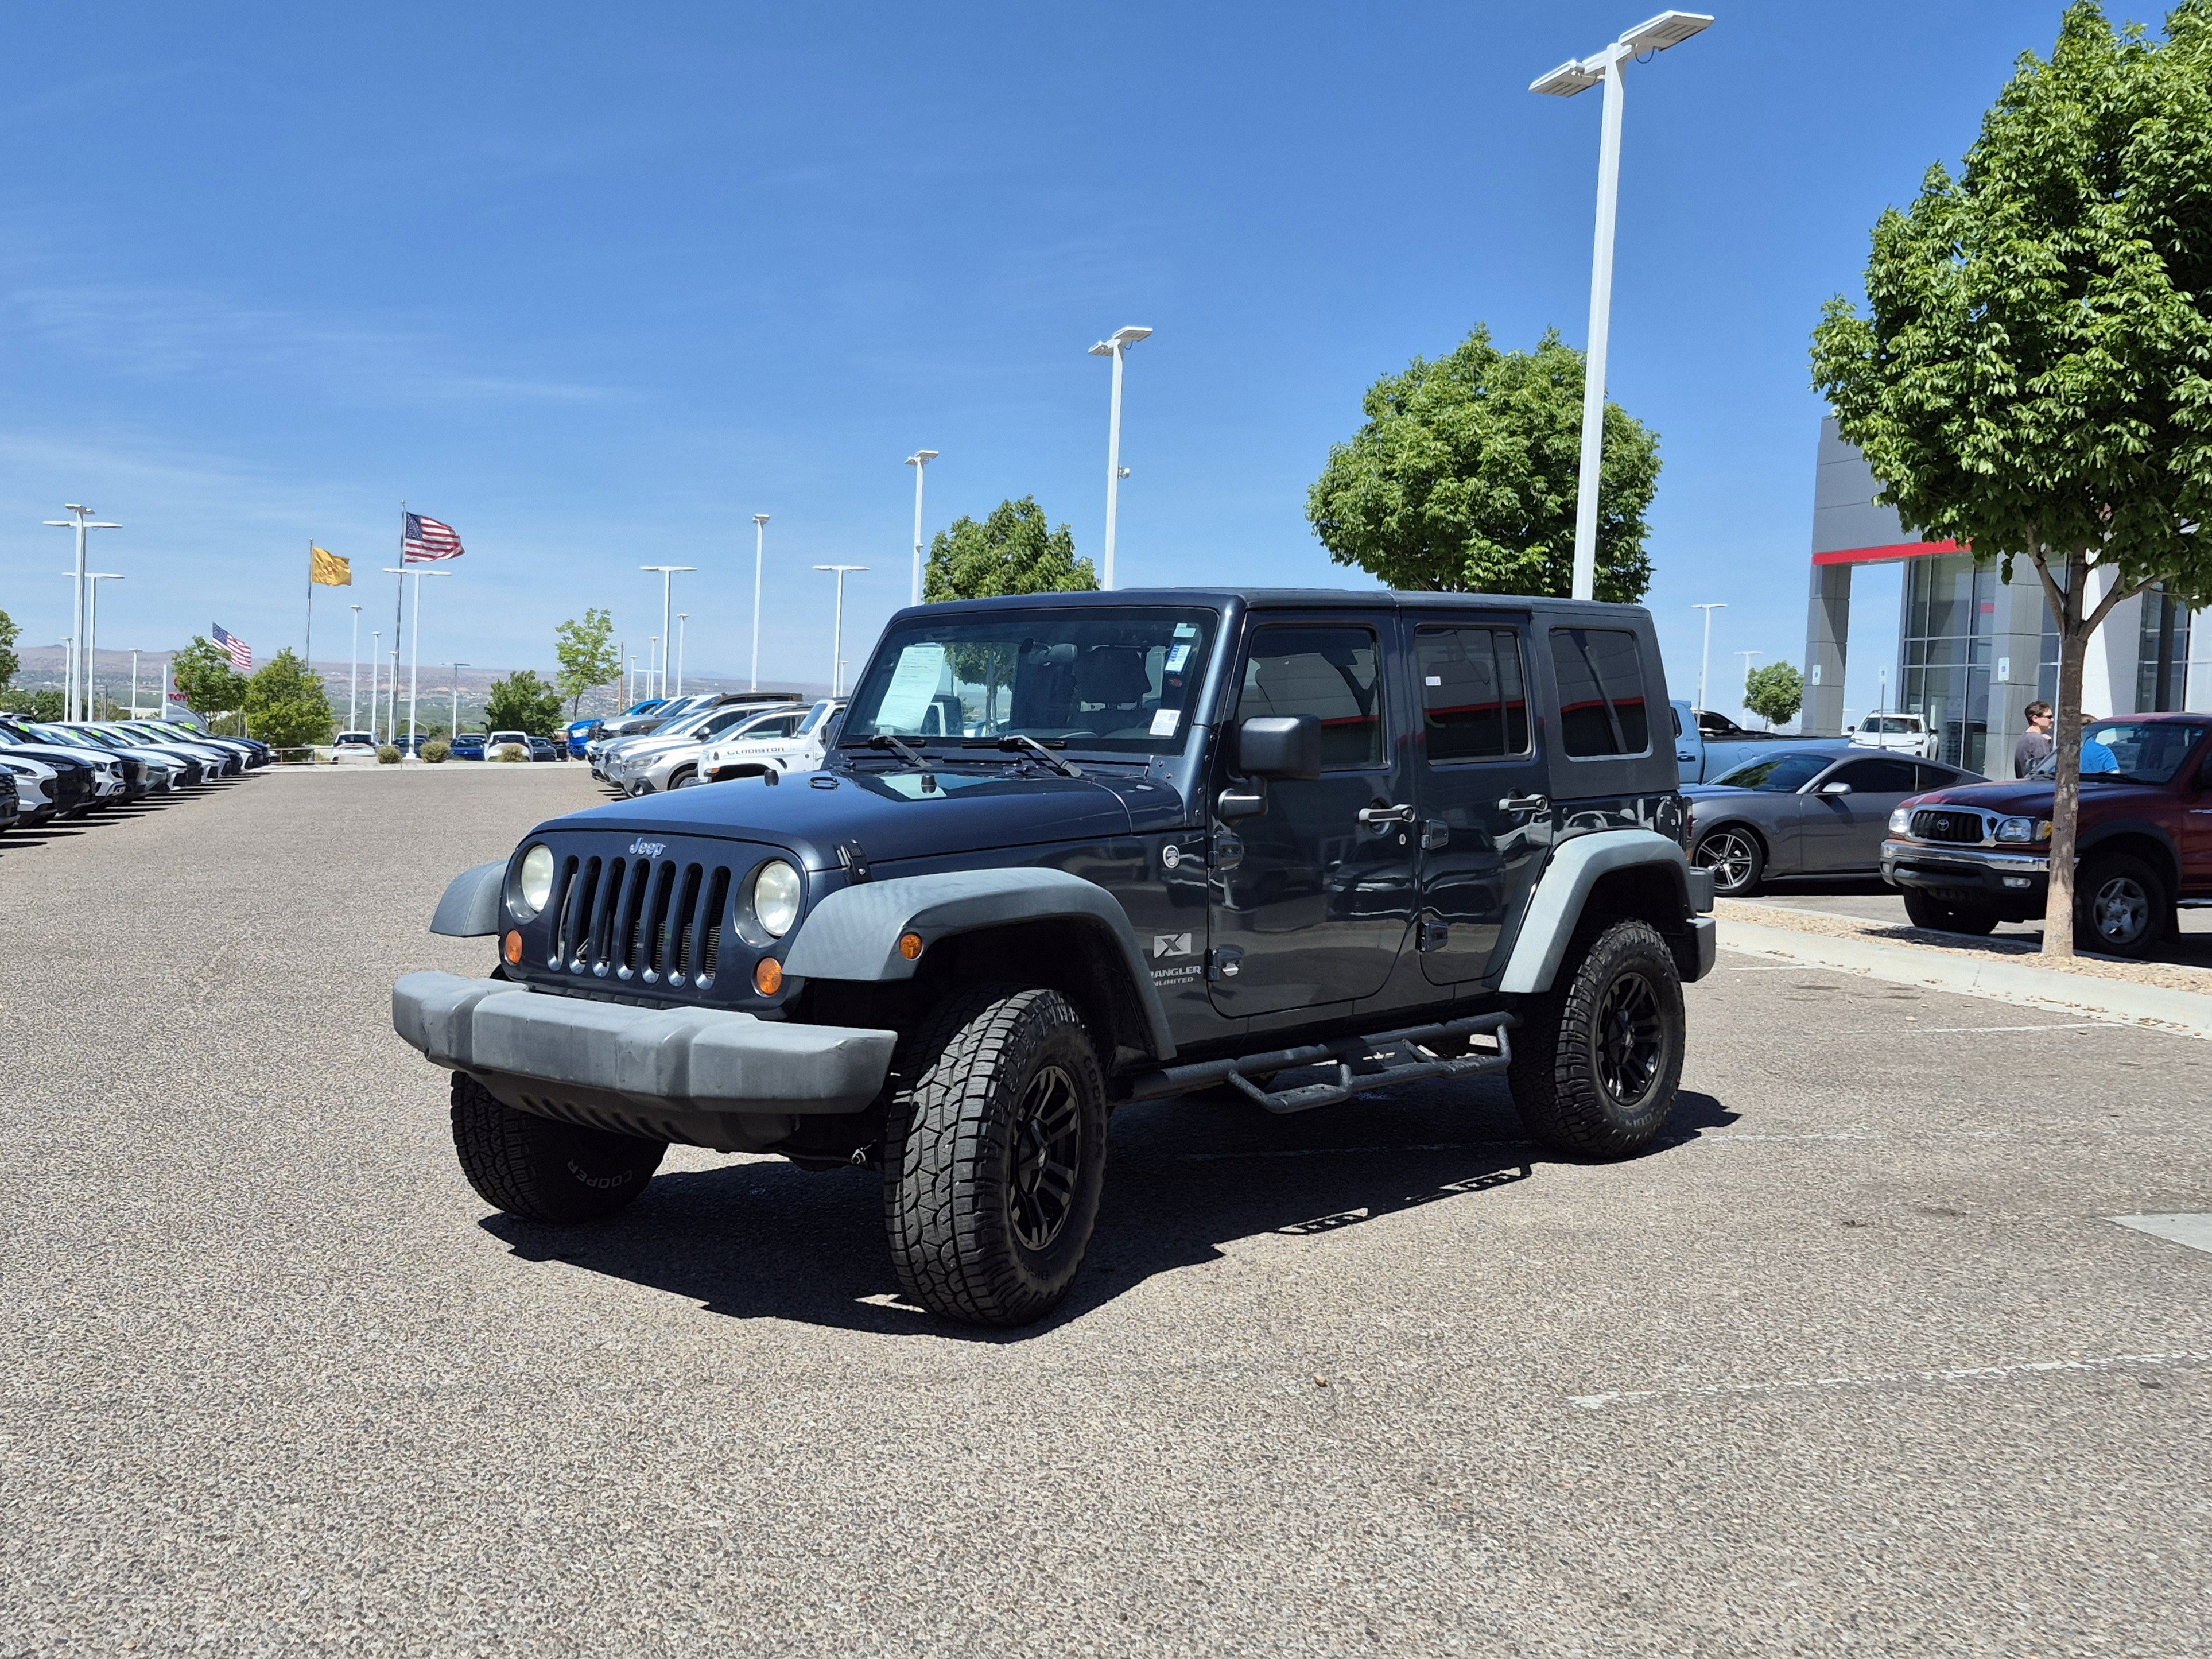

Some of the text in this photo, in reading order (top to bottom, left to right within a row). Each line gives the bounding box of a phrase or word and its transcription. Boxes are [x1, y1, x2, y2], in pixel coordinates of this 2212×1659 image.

[629, 838, 666, 859] Jeep
[1150, 966, 1202, 978] ANGLER
[1154, 976, 1194, 986] NLIMITED
[567, 1159, 632, 1188] COOPER
